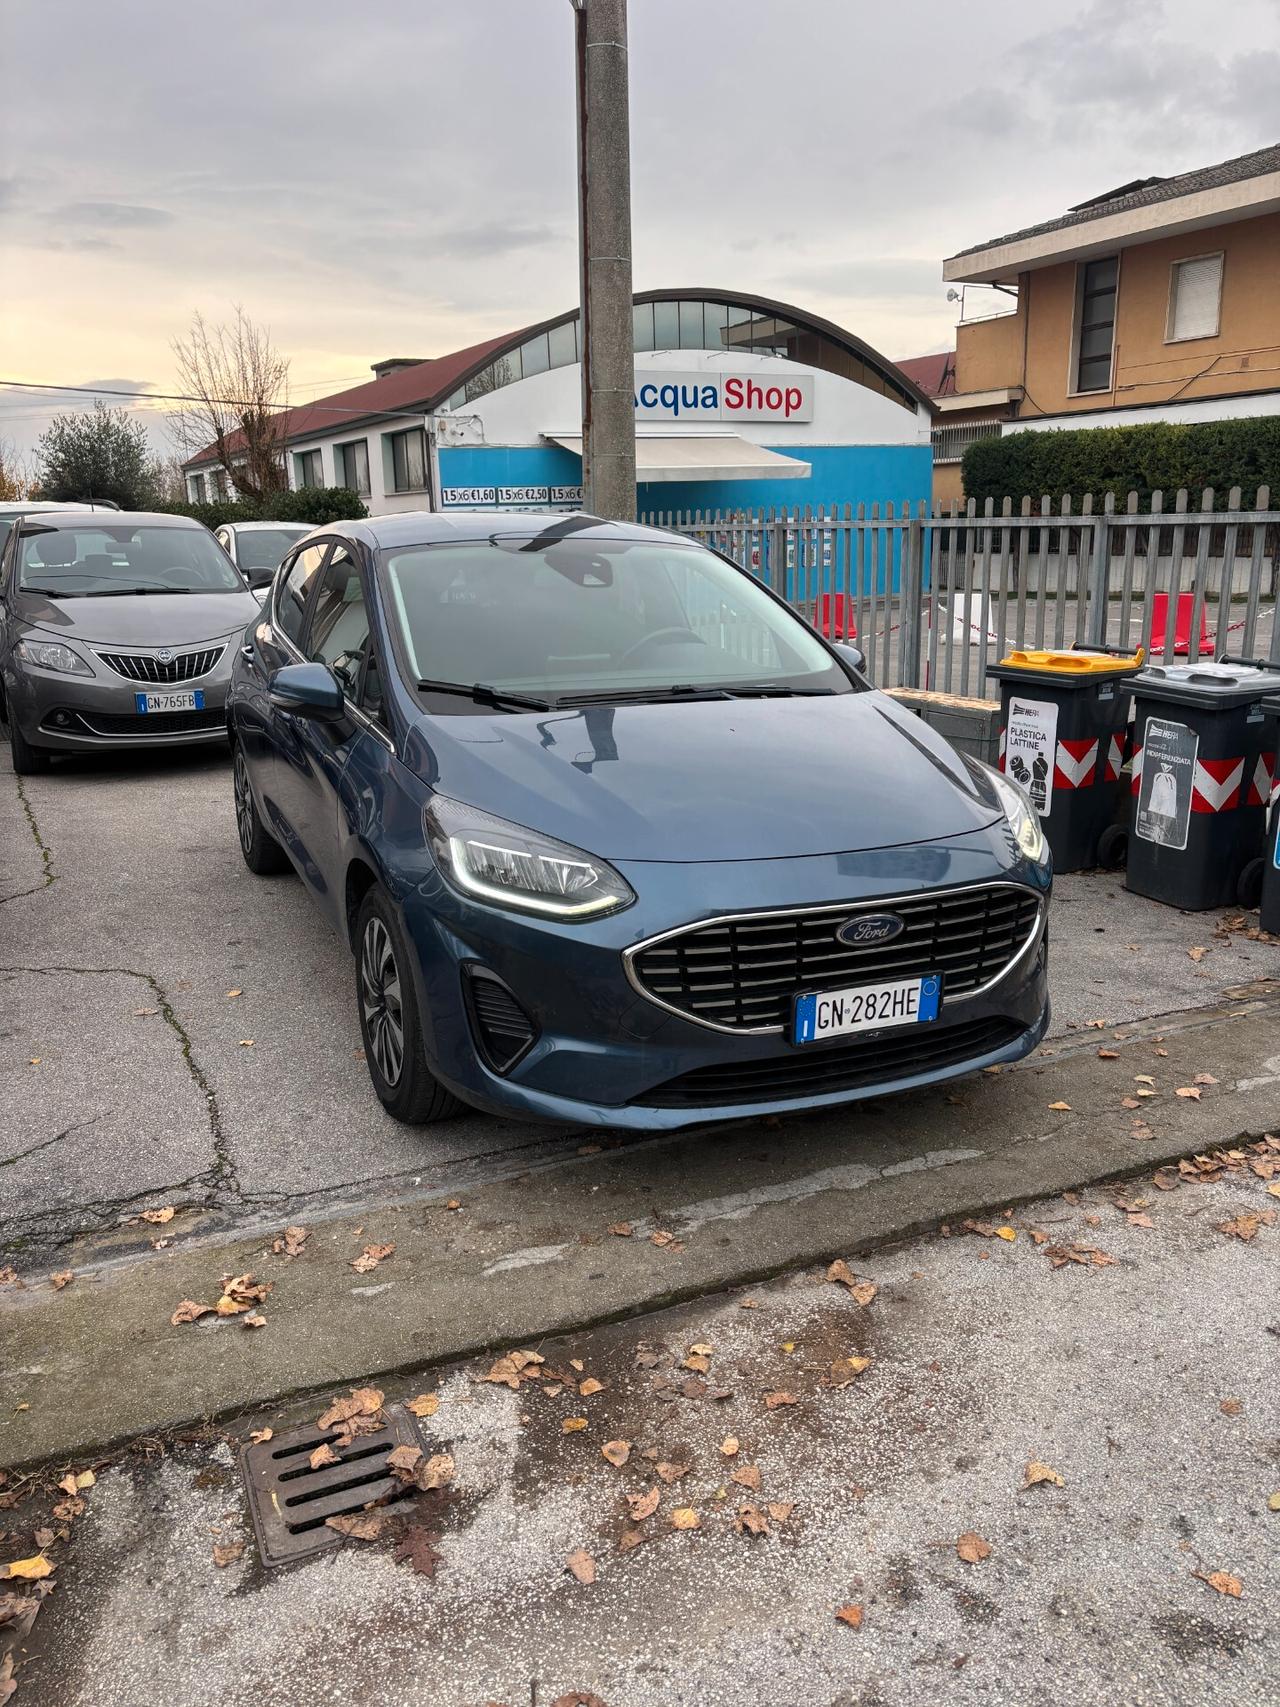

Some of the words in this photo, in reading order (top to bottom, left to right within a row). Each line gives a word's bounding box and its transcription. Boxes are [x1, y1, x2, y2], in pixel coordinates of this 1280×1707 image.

[635, 384, 718, 416] cqua
[725, 378, 802, 418] Shop
[471, 489, 494, 502] €1,60
[525, 488, 547, 501] €2,50
[1010, 727, 1047, 742] PLASTICA
[1010, 737, 1040, 751] LATTINE
[854, 920, 890, 941] Ford
